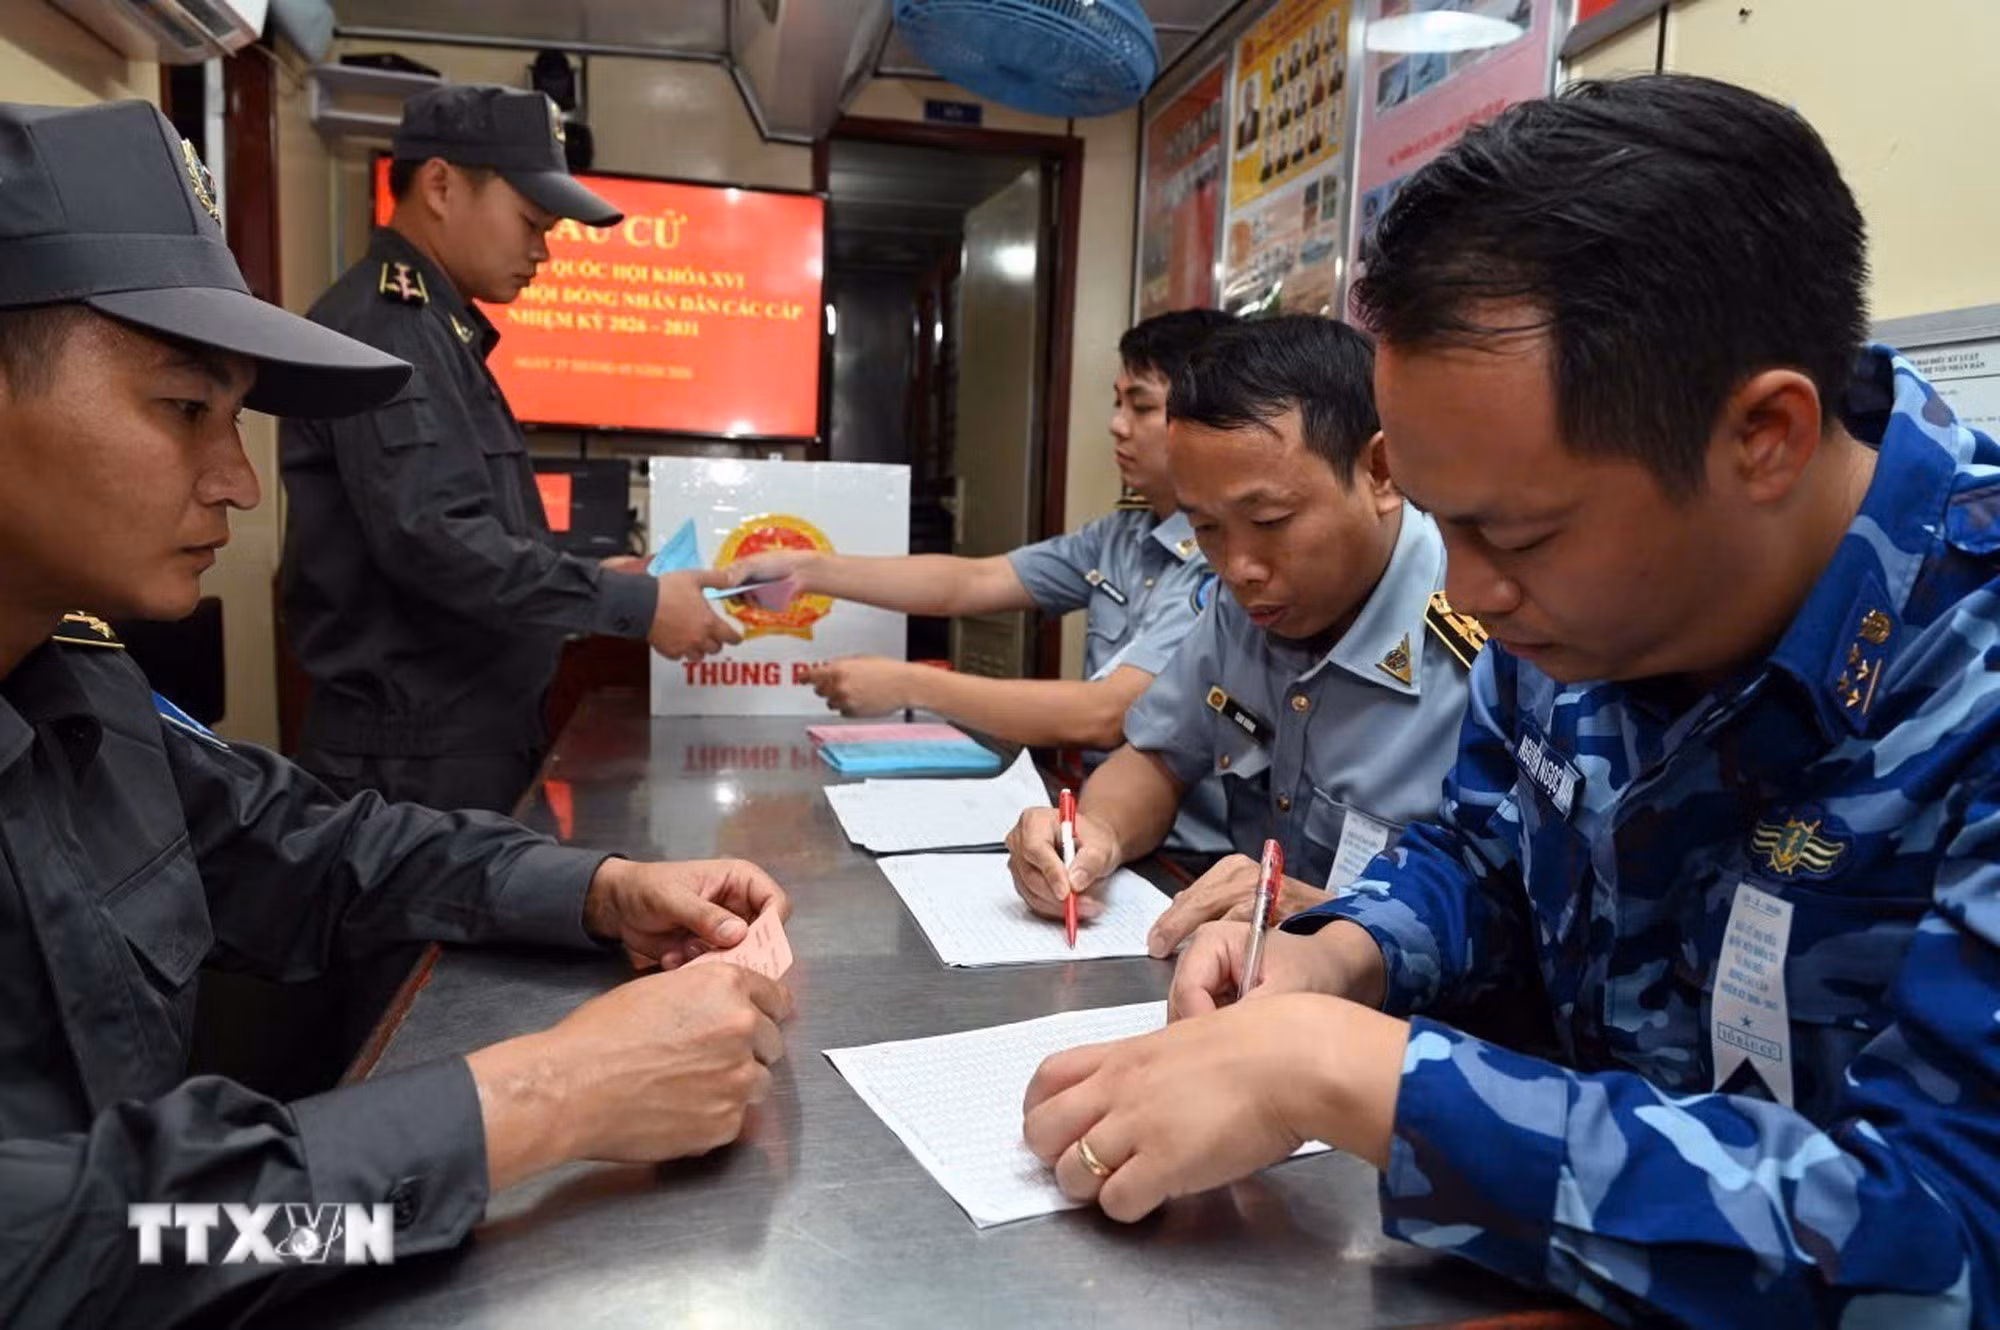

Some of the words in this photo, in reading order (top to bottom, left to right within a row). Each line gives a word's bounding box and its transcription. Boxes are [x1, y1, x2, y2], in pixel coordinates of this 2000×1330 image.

[623, 209, 689, 249] CỬ
[552, 259, 608, 278] QUỐC
[612, 262, 649, 282] HỘI
[652, 266, 707, 287] KHÓA
[711, 271, 745, 288] XVI
[722, 296, 762, 317] CÁC
[682, 657, 781, 686] THÙNG
